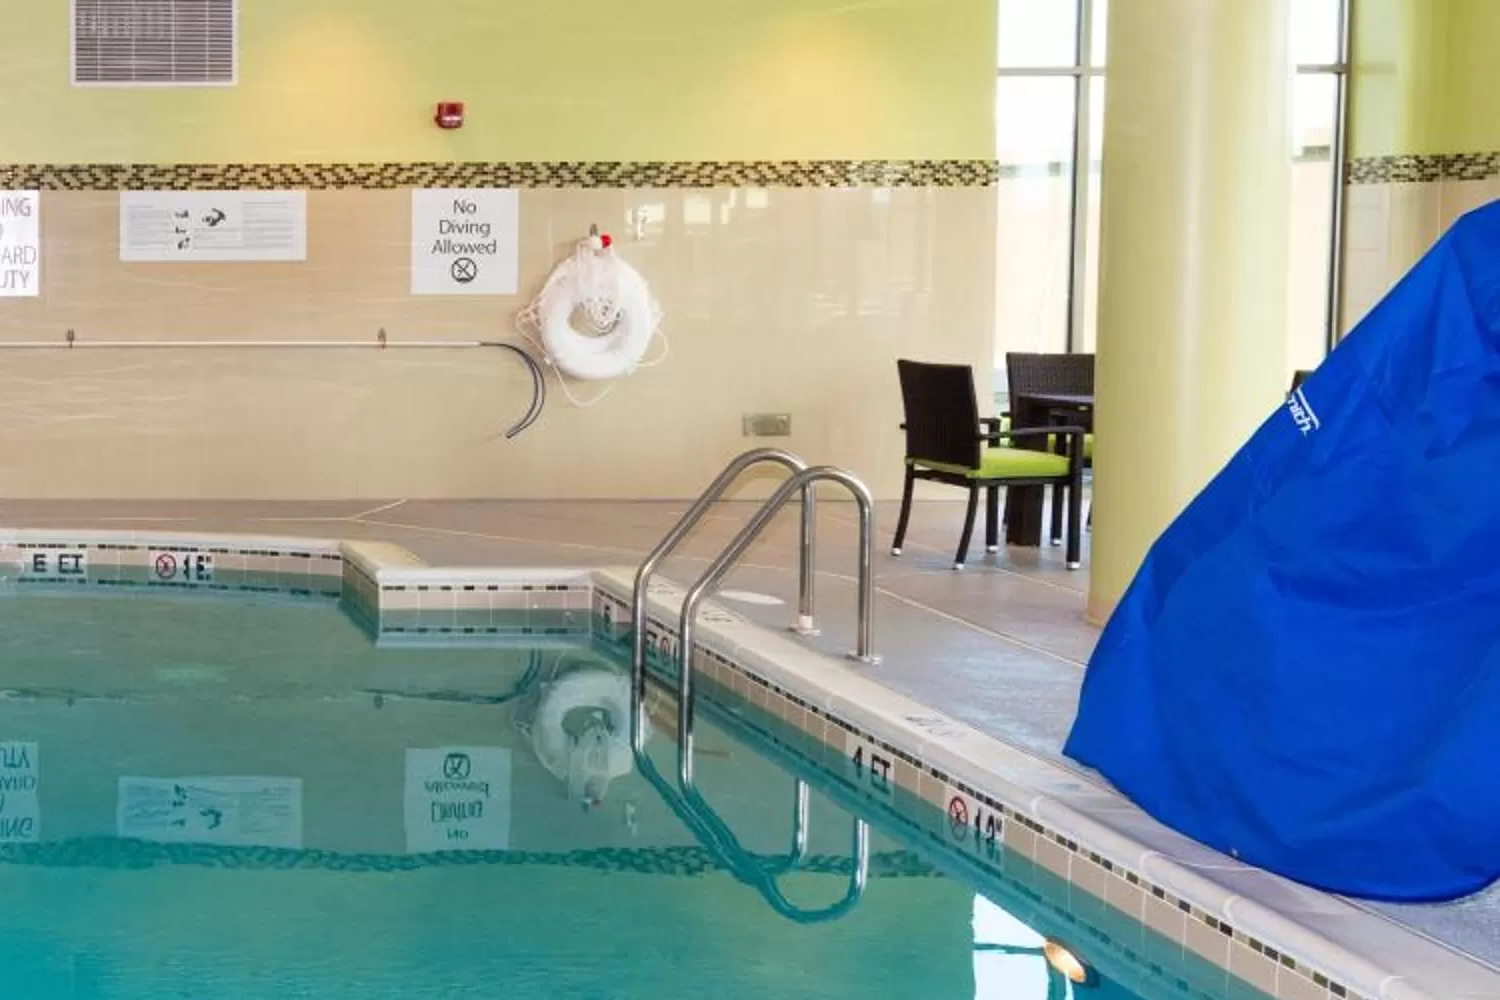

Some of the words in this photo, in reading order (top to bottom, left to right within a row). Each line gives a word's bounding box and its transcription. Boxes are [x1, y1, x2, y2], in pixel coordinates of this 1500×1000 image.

[453, 199, 477, 214] No
[439, 219, 491, 238] Diving
[431, 239, 497, 254] Allowed
